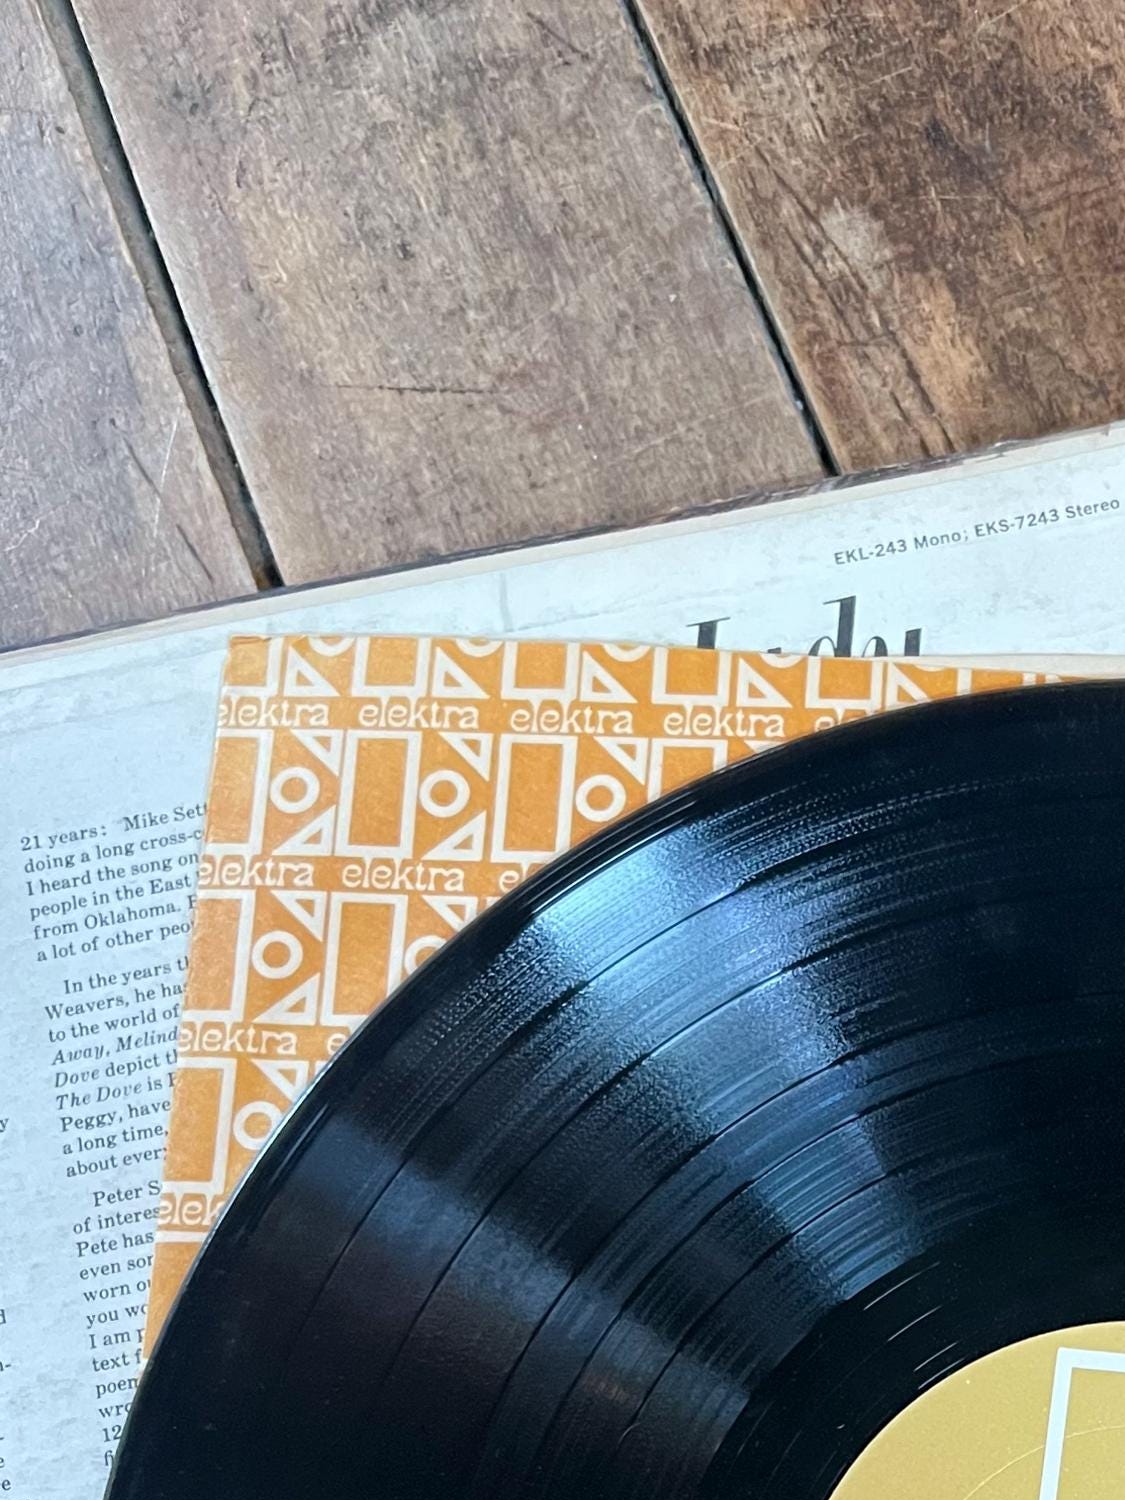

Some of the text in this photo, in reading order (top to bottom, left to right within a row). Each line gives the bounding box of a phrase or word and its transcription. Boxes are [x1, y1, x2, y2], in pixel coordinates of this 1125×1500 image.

[834, 498, 1121, 566] EKL-243 Mono; EKS-7243 Stereo
[358, 698, 785, 738] elektra elektra elektra
[20, 811, 168, 851] 21 years: Mike
[24, 842, 134, 873] doing a long
[26, 853, 198, 896] I heard the song on
[341, 860, 465, 892] elektra
[29, 874, 191, 921] people in the East
[33, 903, 180, 939] from Oklahoma.
[37, 929, 153, 961] a lot of other
[63, 963, 171, 994] In the years
[44, 988, 155, 1019] Weavers, he
[48, 1002, 179, 1042] to the world of
[51, 1045, 110, 1065] Away,
[54, 1053, 160, 1087] Dove depict
[55, 1076, 162, 1109] The Dove is
[60, 1100, 170, 1132] Peggy, have
[62, 1125, 168, 1154] a long time,
[66, 1154, 117, 1177] about
[92, 1187, 142, 1207] Peter
[72, 1216, 90, 1233] of
[76, 1230, 155, 1258] Pete has
[79, 1261, 122, 1281] even
[83, 1284, 131, 1302] worn
[86, 1307, 120, 1330] you
[89, 1330, 132, 1349] I am
[92, 1352, 131, 1373] text
